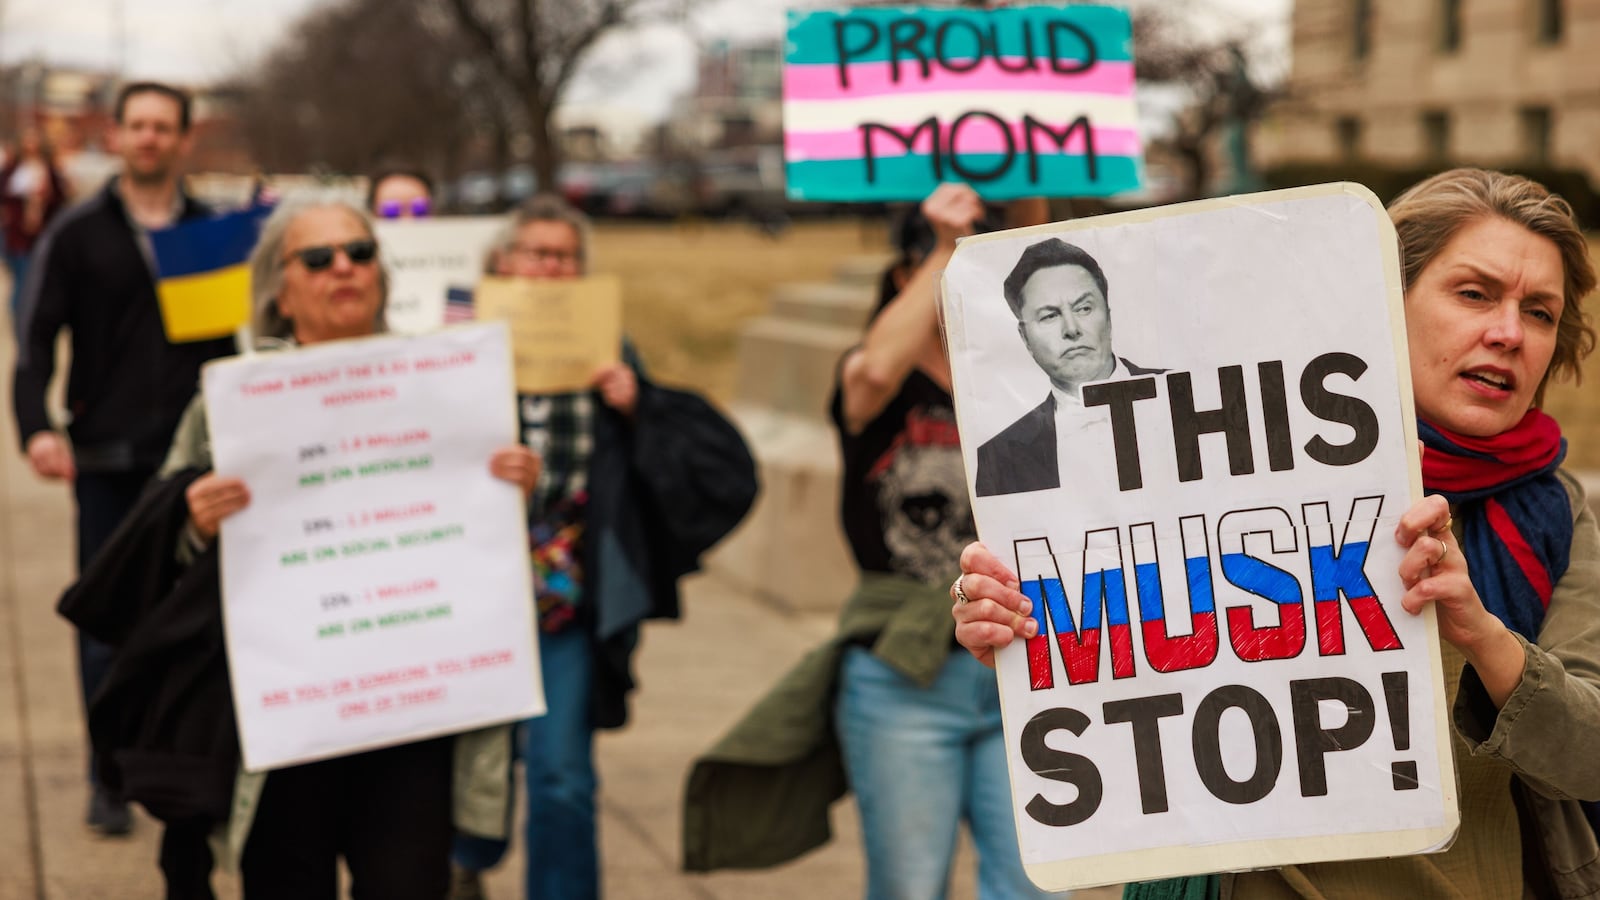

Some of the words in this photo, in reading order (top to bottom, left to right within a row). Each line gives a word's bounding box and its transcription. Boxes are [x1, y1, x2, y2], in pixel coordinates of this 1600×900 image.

[833, 17, 1098, 89] PROUD
[857, 110, 1098, 185] MOM
[289, 369, 340, 390] ABOUT
[344, 364, 373, 379] THE
[412, 351, 476, 372] MILLION
[364, 429, 430, 448] MILLION
[1082, 352, 1380, 491] THIS
[297, 471, 327, 488] ARE
[328, 465, 354, 482] ON
[355, 455, 433, 477] MEDICAID
[372, 502, 436, 522] MILLION
[279, 549, 309, 567] ARE
[312, 545, 338, 562] ON
[340, 538, 393, 557] SOCIAL
[395, 523, 466, 547] SECURITY
[376, 579, 438, 599] MILLION
[1013, 495, 1405, 691] MUSK
[316, 620, 346, 639] ARE
[349, 617, 374, 634] ON
[375, 604, 453, 628] MEDICARE
[261, 689, 291, 706] ARE
[294, 684, 328, 700] YOU
[356, 664, 429, 691] SOMEONE
[1020, 671, 1419, 827] STOP!
